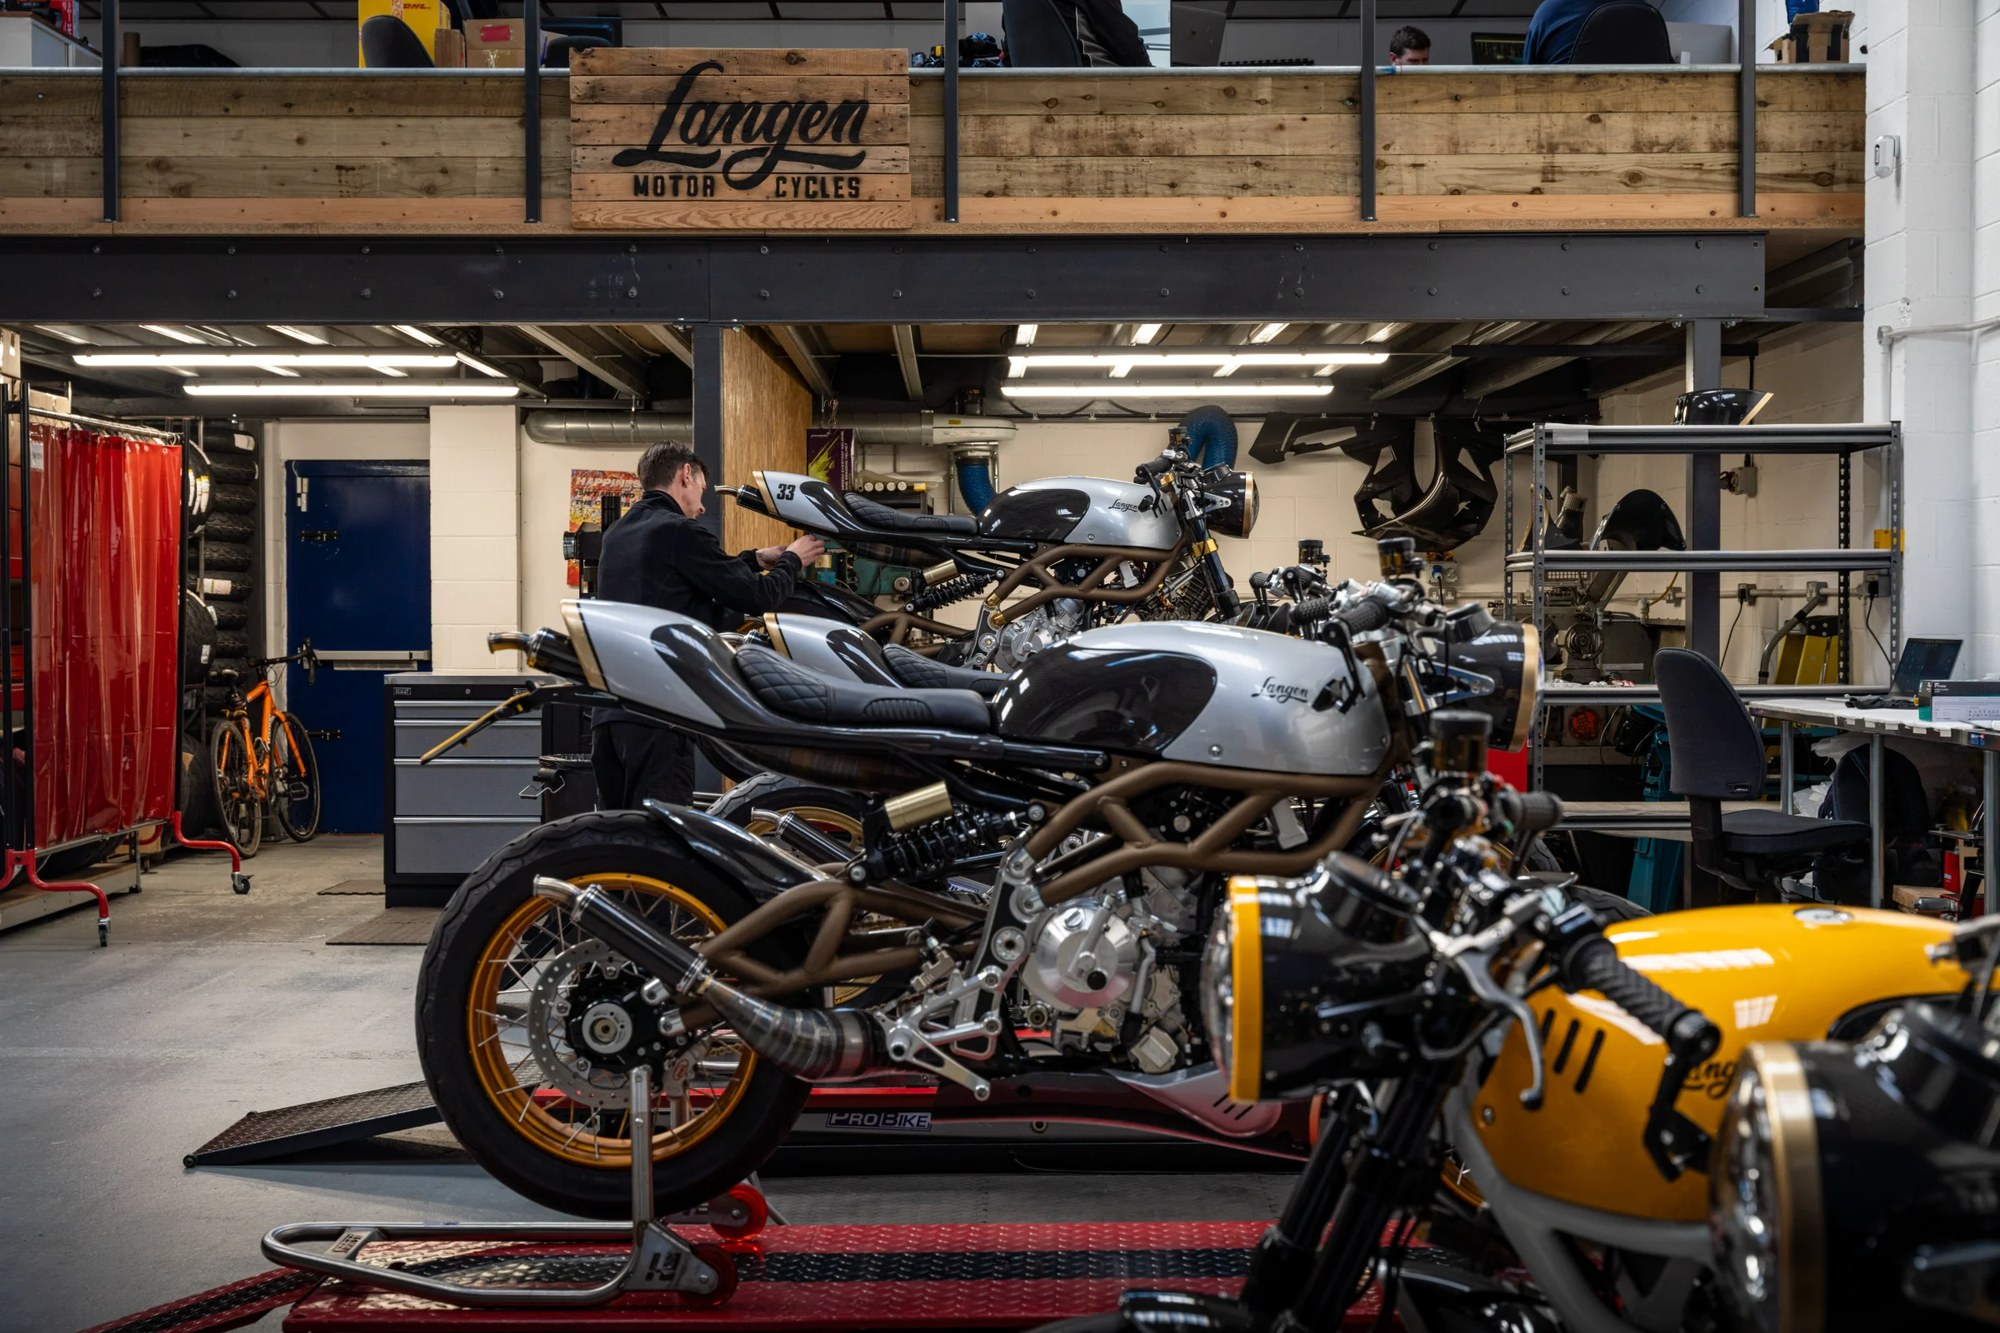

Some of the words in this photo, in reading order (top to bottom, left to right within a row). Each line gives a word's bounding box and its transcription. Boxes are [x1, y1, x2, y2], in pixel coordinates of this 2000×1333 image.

[612, 60, 870, 190] Langen
[633, 174, 715, 197] MOTOR
[775, 175, 860, 198] CYCLES
[575, 476, 641, 488] HAPPINES
[776, 483, 796, 501] 33
[1108, 498, 1138, 513] Langen
[1250, 676, 1309, 704] Langen
